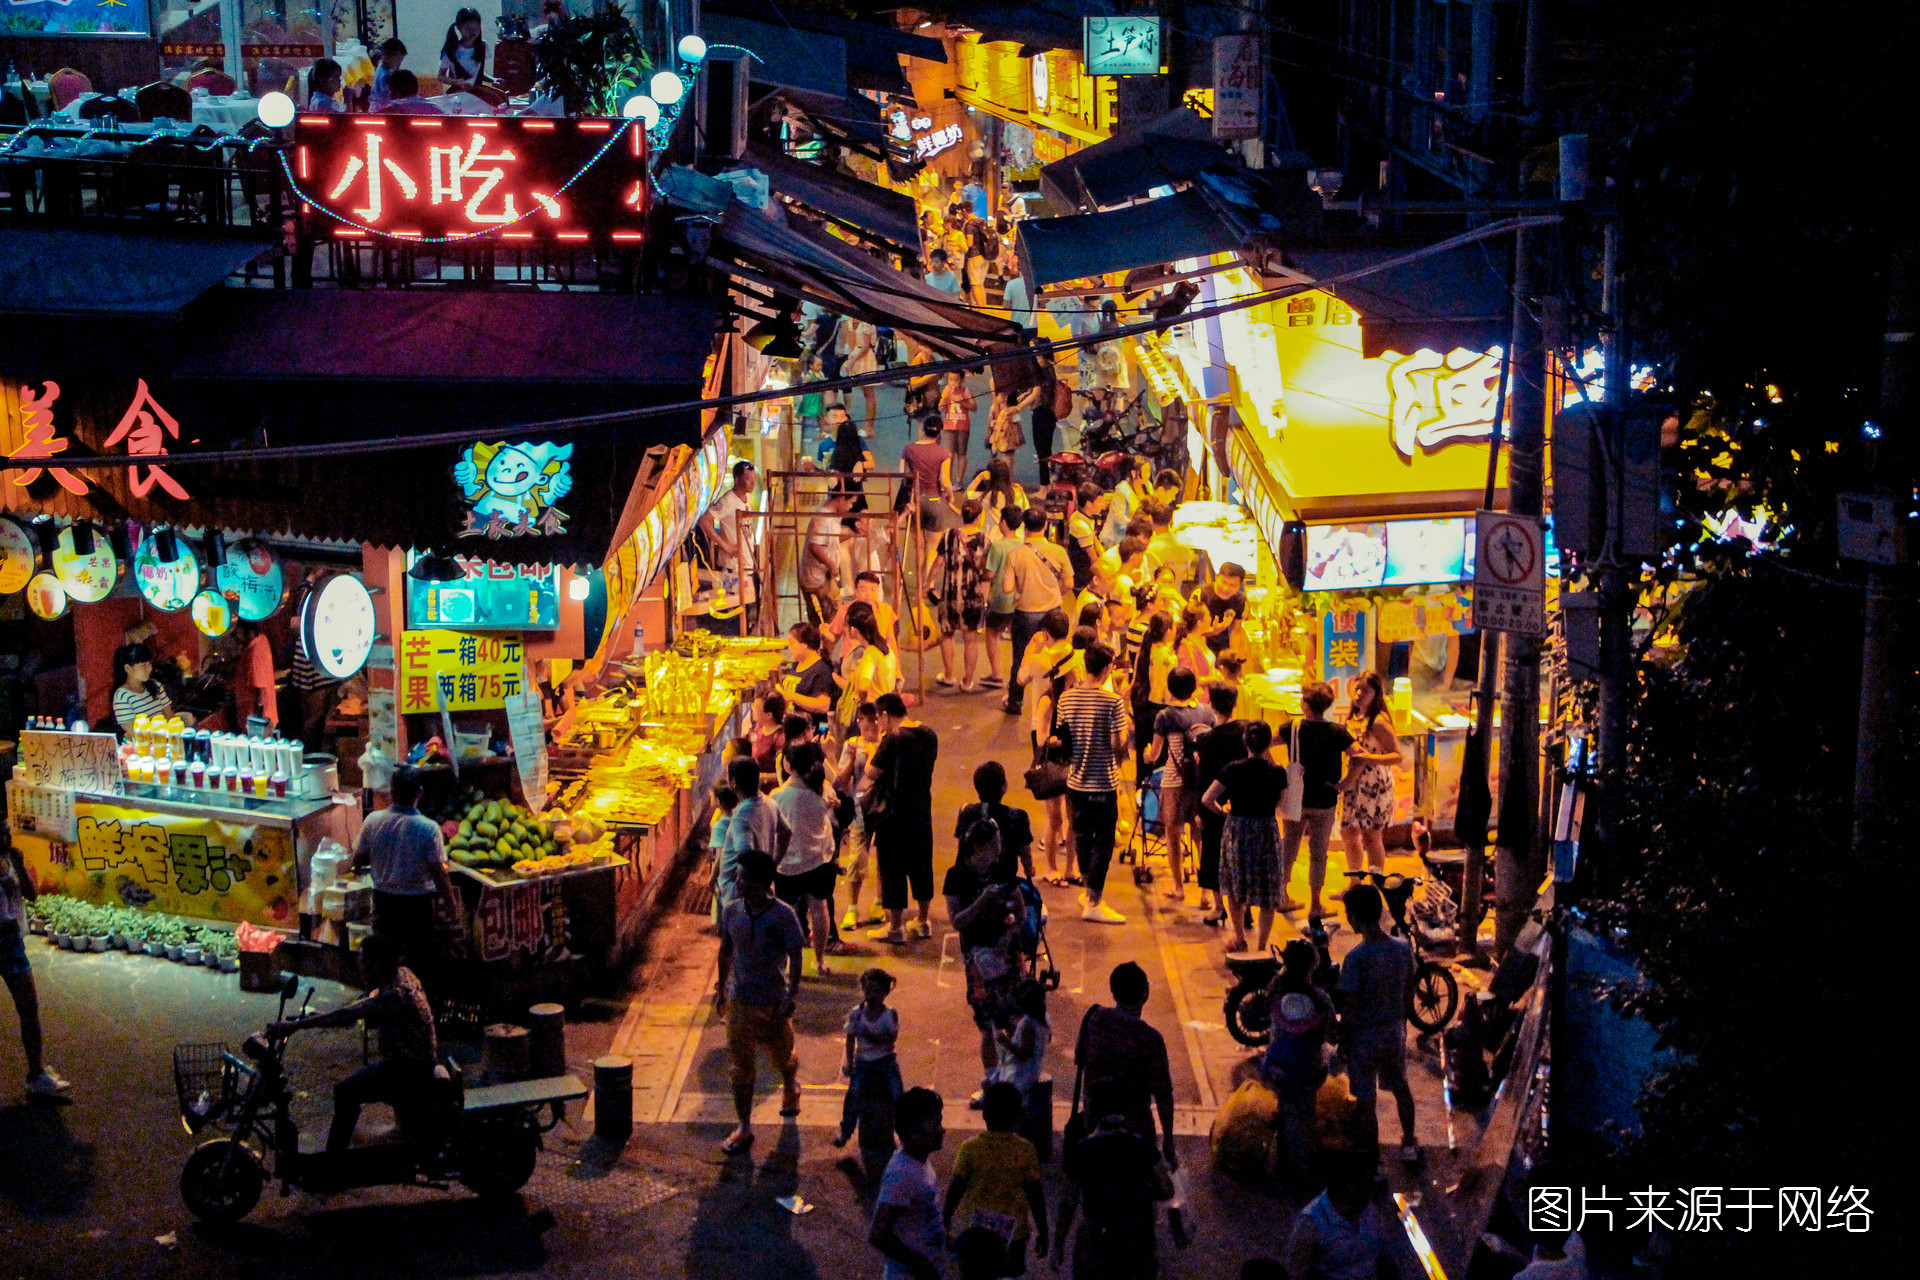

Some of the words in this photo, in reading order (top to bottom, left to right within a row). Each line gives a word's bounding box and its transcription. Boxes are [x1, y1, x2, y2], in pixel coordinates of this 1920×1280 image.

[8, 378, 190, 500] 美食
[405, 636, 431, 710] 芒果
[77, 816, 251, 895] 鲜榨果汁
